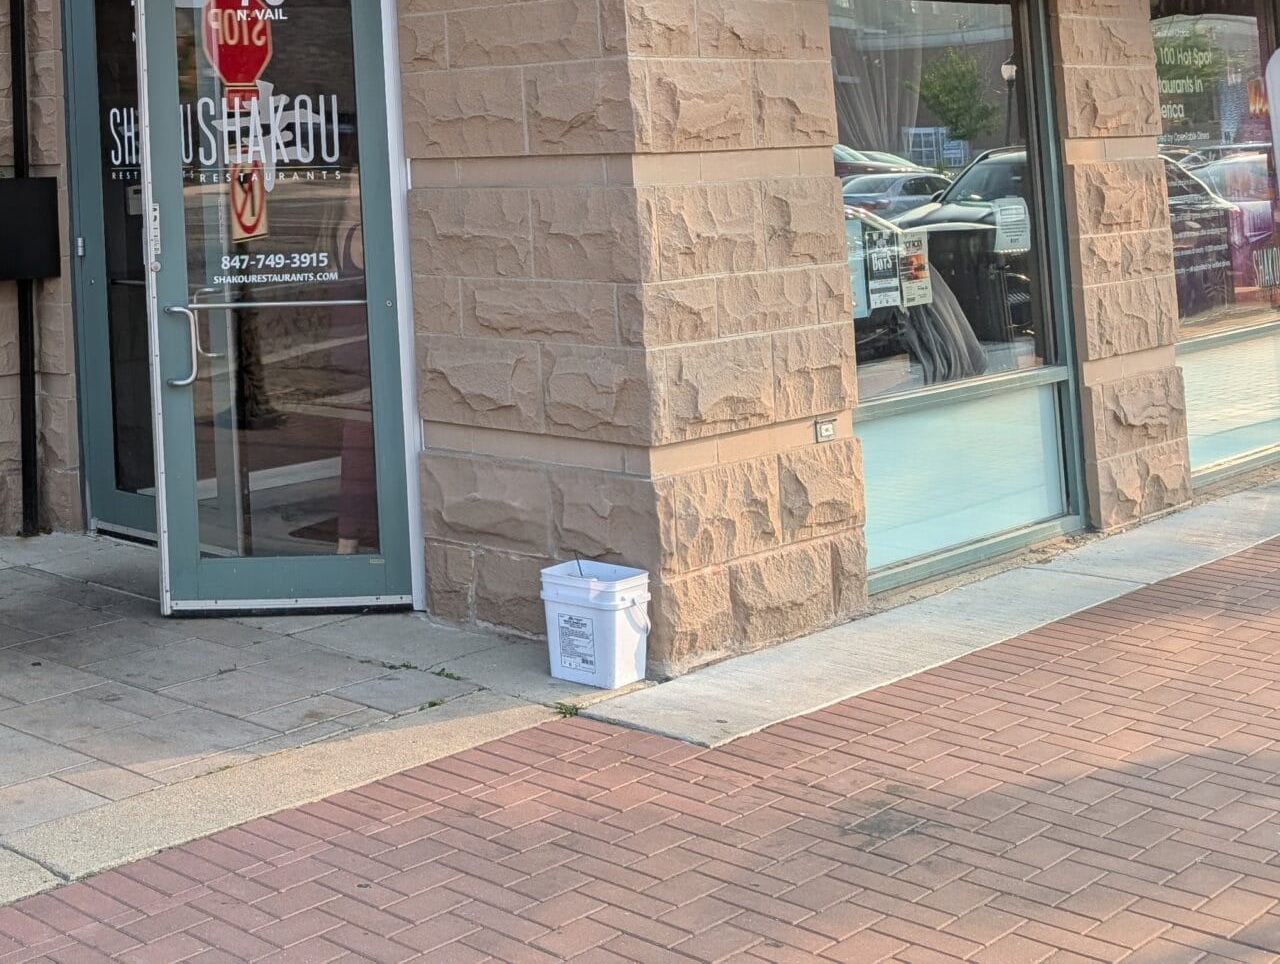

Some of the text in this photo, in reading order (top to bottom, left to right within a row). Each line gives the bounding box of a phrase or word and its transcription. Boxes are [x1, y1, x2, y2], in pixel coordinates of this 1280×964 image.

[236, 8, 288, 21] N. VAIL
[197, 94, 340, 166] SHAKOU
[199, 170, 342, 184] RESTAURANTS
[221, 252, 329, 271] 847-749-3915
[213, 271, 339, 285] SHAKOURESTAURANTS.COM
